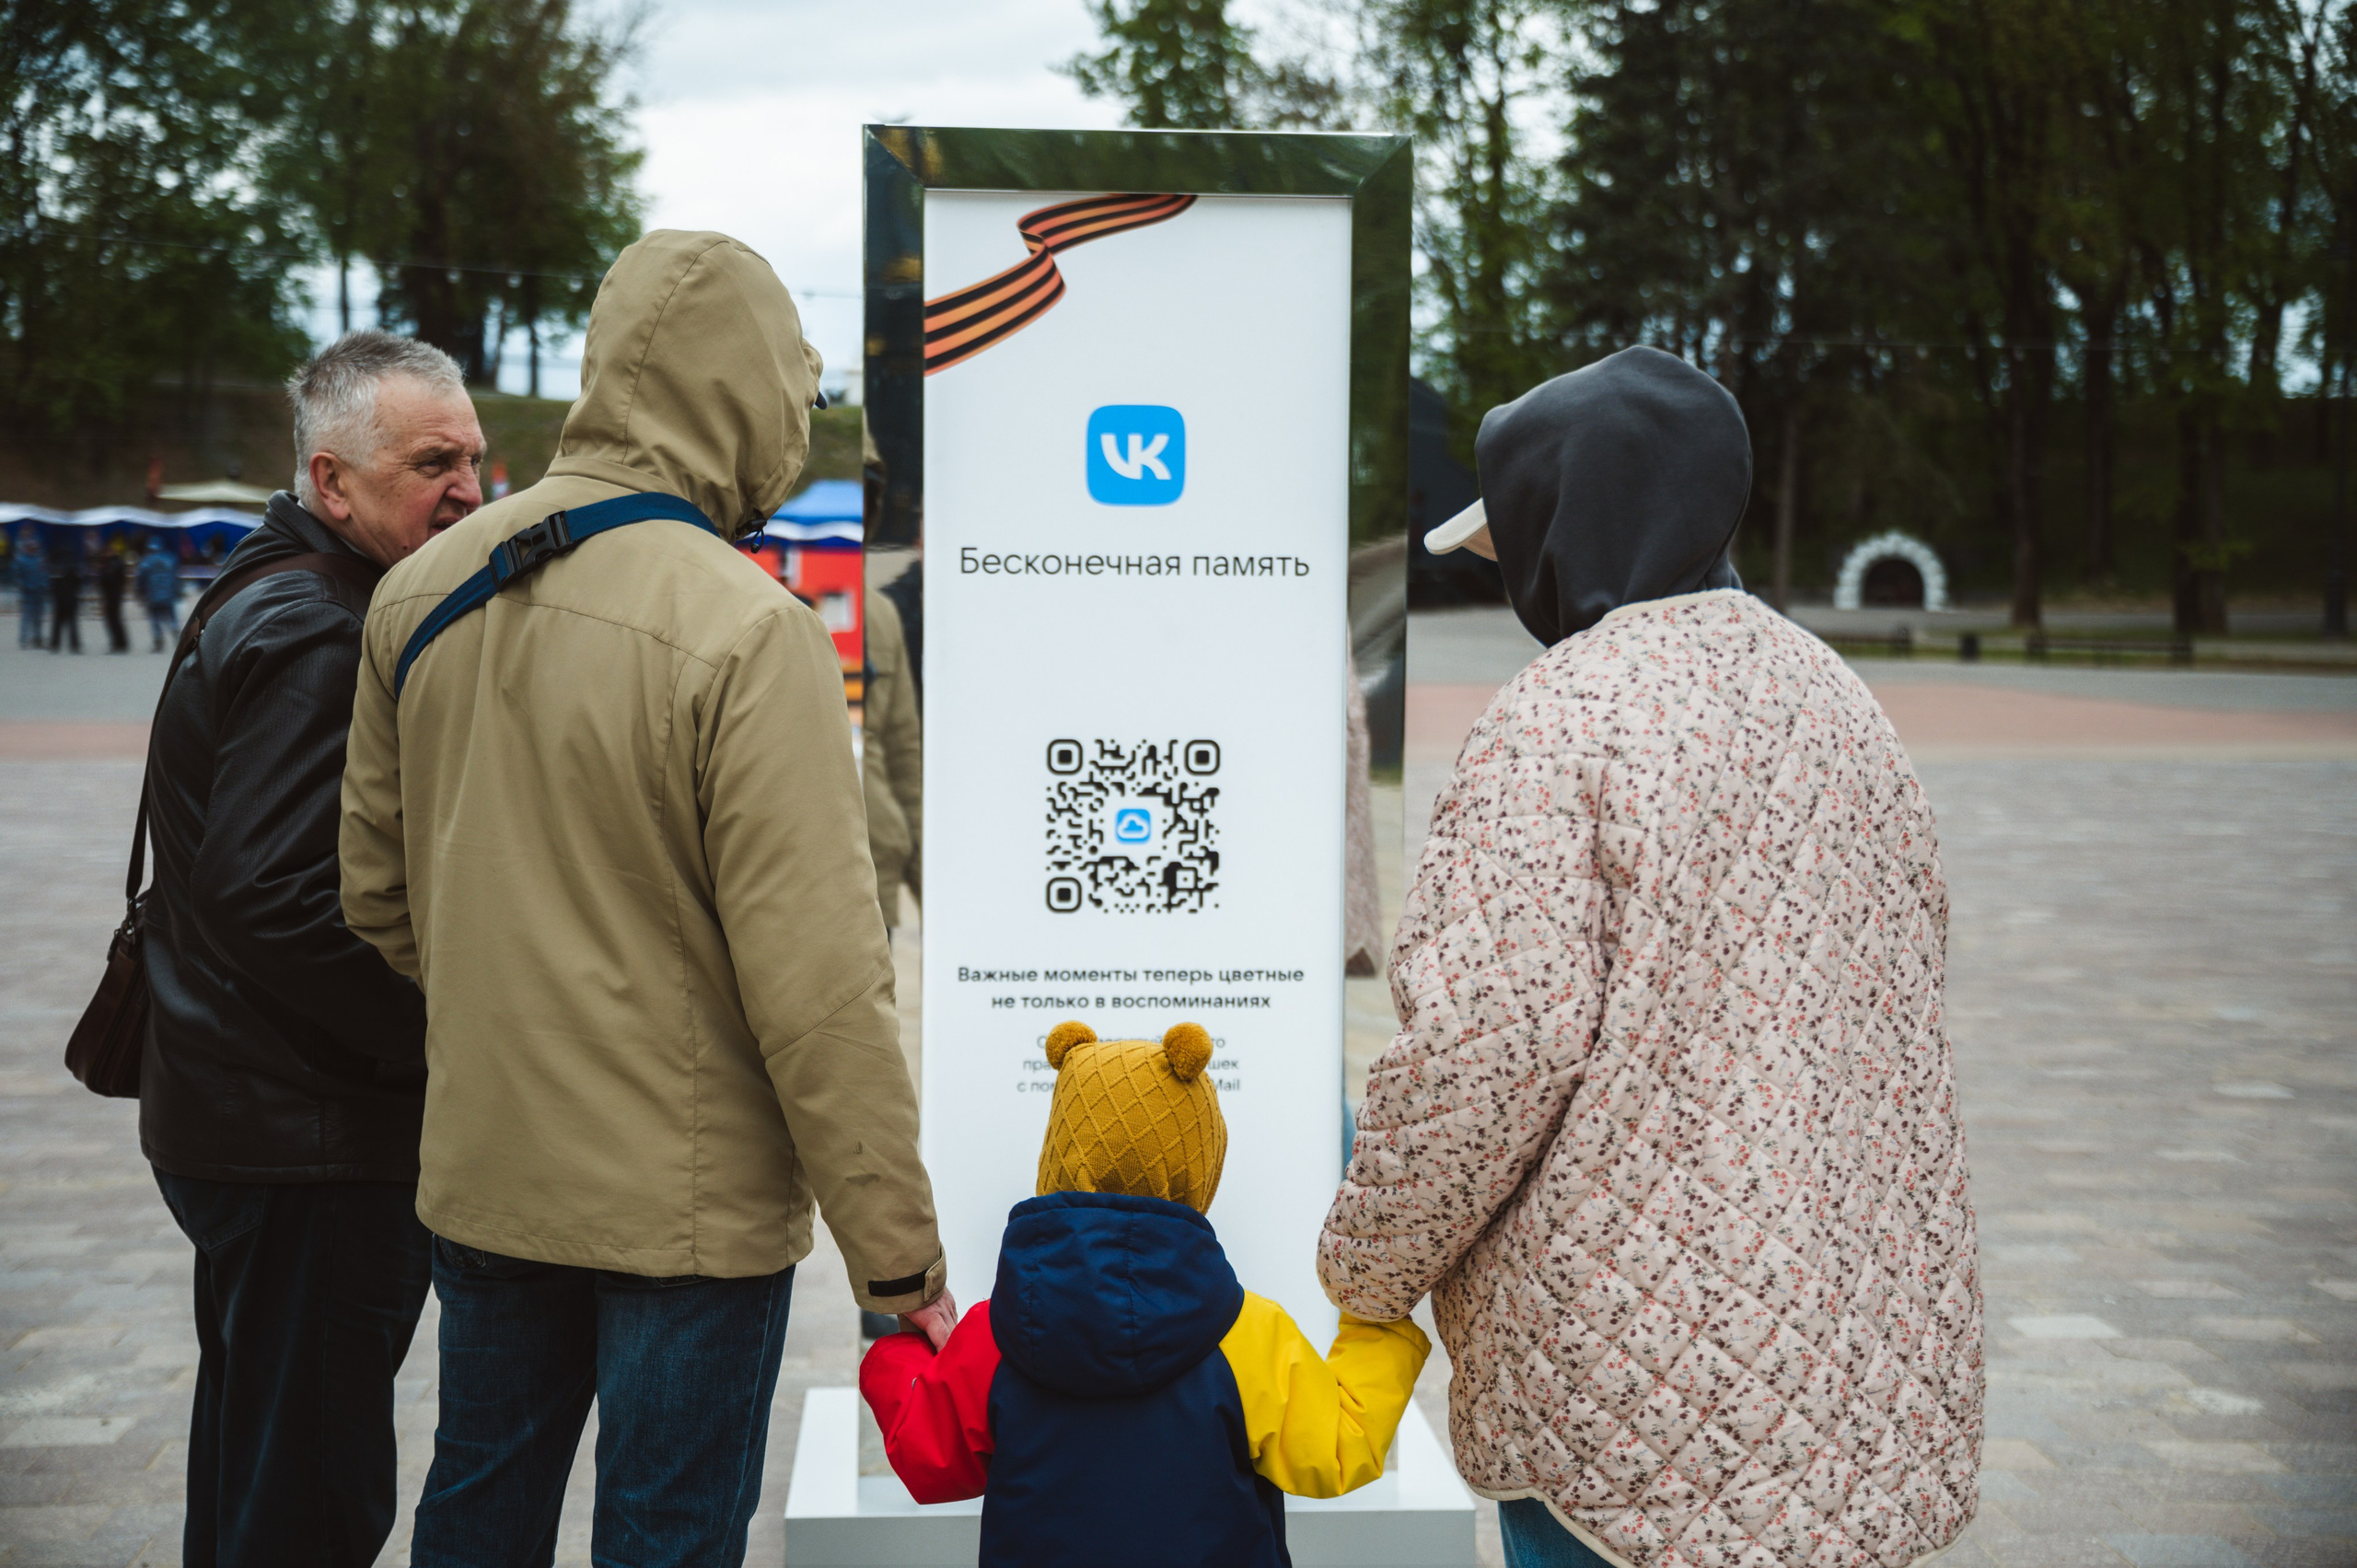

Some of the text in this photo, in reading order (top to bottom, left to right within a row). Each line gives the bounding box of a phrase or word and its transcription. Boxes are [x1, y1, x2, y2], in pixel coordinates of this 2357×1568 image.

[1100, 433, 1172, 481] VK
[959, 546, 1310, 577] Бесконечная память
[958, 967, 1305, 986] Важные моменты теперь цветные
[992, 995, 1271, 1010] не только в воспоминаниях
